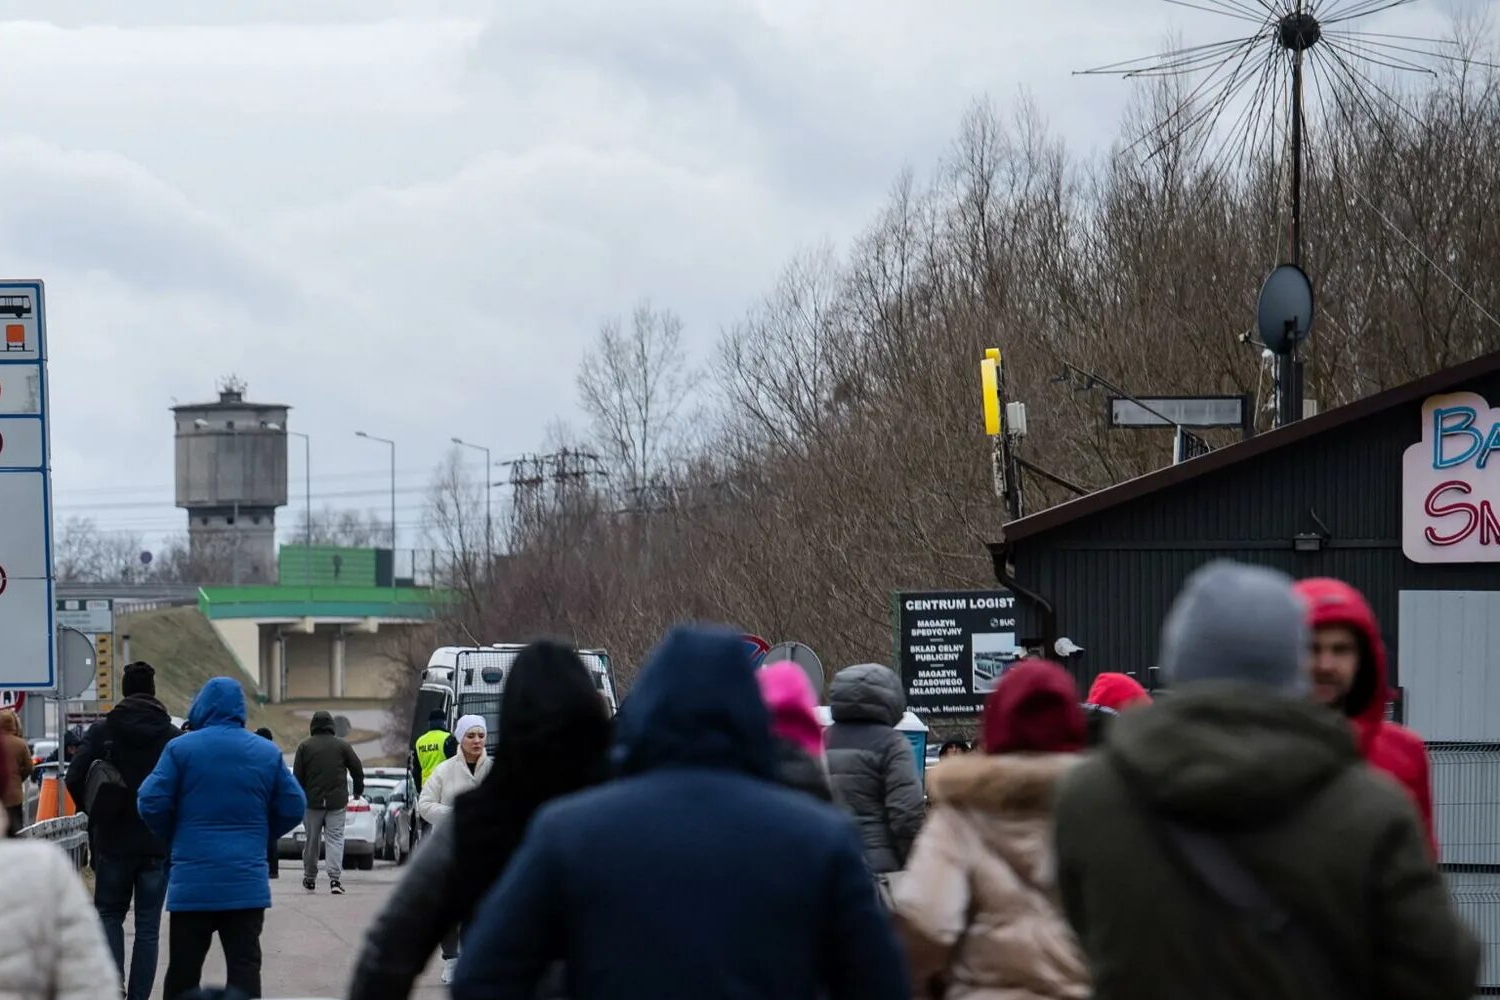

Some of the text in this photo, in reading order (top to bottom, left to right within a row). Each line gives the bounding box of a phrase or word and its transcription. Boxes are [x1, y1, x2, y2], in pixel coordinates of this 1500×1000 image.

[905, 598, 967, 611] CENTRUM
[916, 619, 956, 628] MAGAZYN
[918, 669, 957, 678] MAGAZYN
